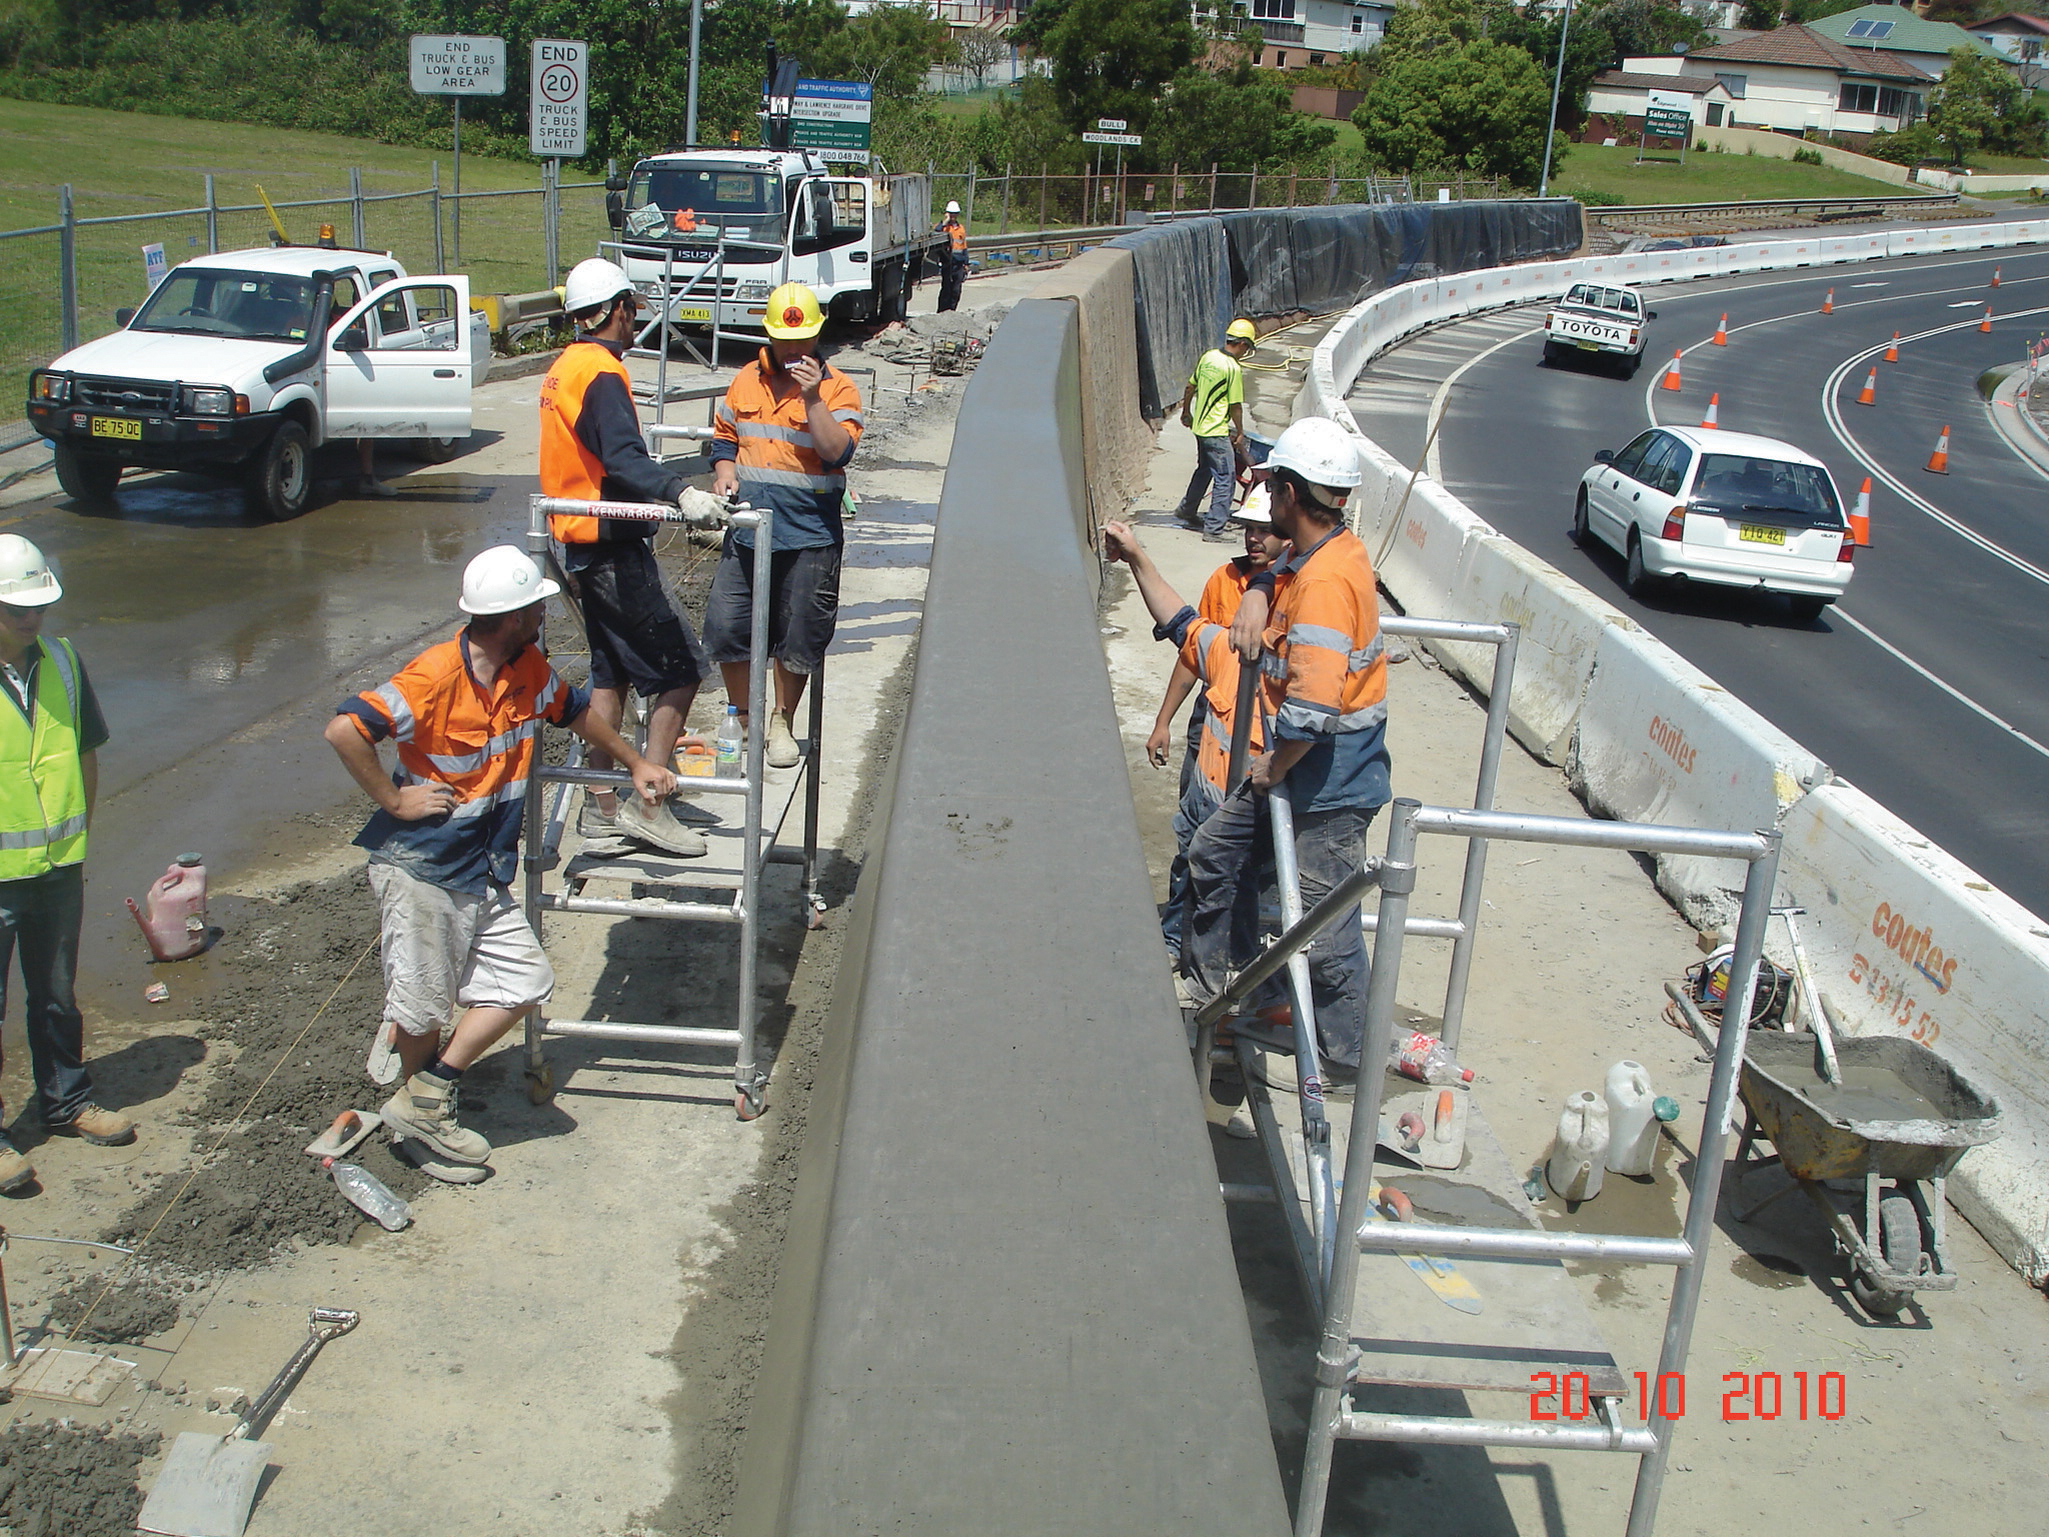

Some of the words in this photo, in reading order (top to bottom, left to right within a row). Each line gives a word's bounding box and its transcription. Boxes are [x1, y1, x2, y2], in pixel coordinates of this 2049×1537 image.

[445, 43, 470, 51] END
[541, 46, 578, 61] END
[421, 54, 456, 63] TRUCK
[474, 55, 495, 64] BUS
[426, 66, 450, 75] LOW
[457, 66, 489, 76] GEAR
[441, 78, 475, 87] AREA
[546, 74, 571, 92] 20
[809, 84, 829, 92] TRAFFIC
[829, 86, 856, 94] AUTHORITY
[539, 104, 578, 115] TRUCK
[1649, 110, 1667, 119] Sales
[1668, 112, 1687, 121] Office
[553, 117, 577, 126] BUS
[1100, 120, 1125, 129] BULLI
[539, 128, 578, 138] SPEED
[542, 139, 574, 149] LIMIT
[1085, 134, 1127, 143] WOODLANDS
[1129, 136, 1140, 144] CK
[820, 151, 837, 160] 1800
[853, 152, 866, 161] 766
[147, 251, 163, 266] ATF
[678, 250, 719, 259] ISUZU
[1561, 320, 1620, 340] TOYOTA
[94, 419, 107, 433] BE
[111, 421, 124, 434] 75
[126, 422, 139, 436] QC
[592, 505, 661, 520] KENNARDS
[1767, 529, 1784, 543] 421
[1872, 902, 1958, 995] coates
[1911, 1011, 1941, 1050] 52
